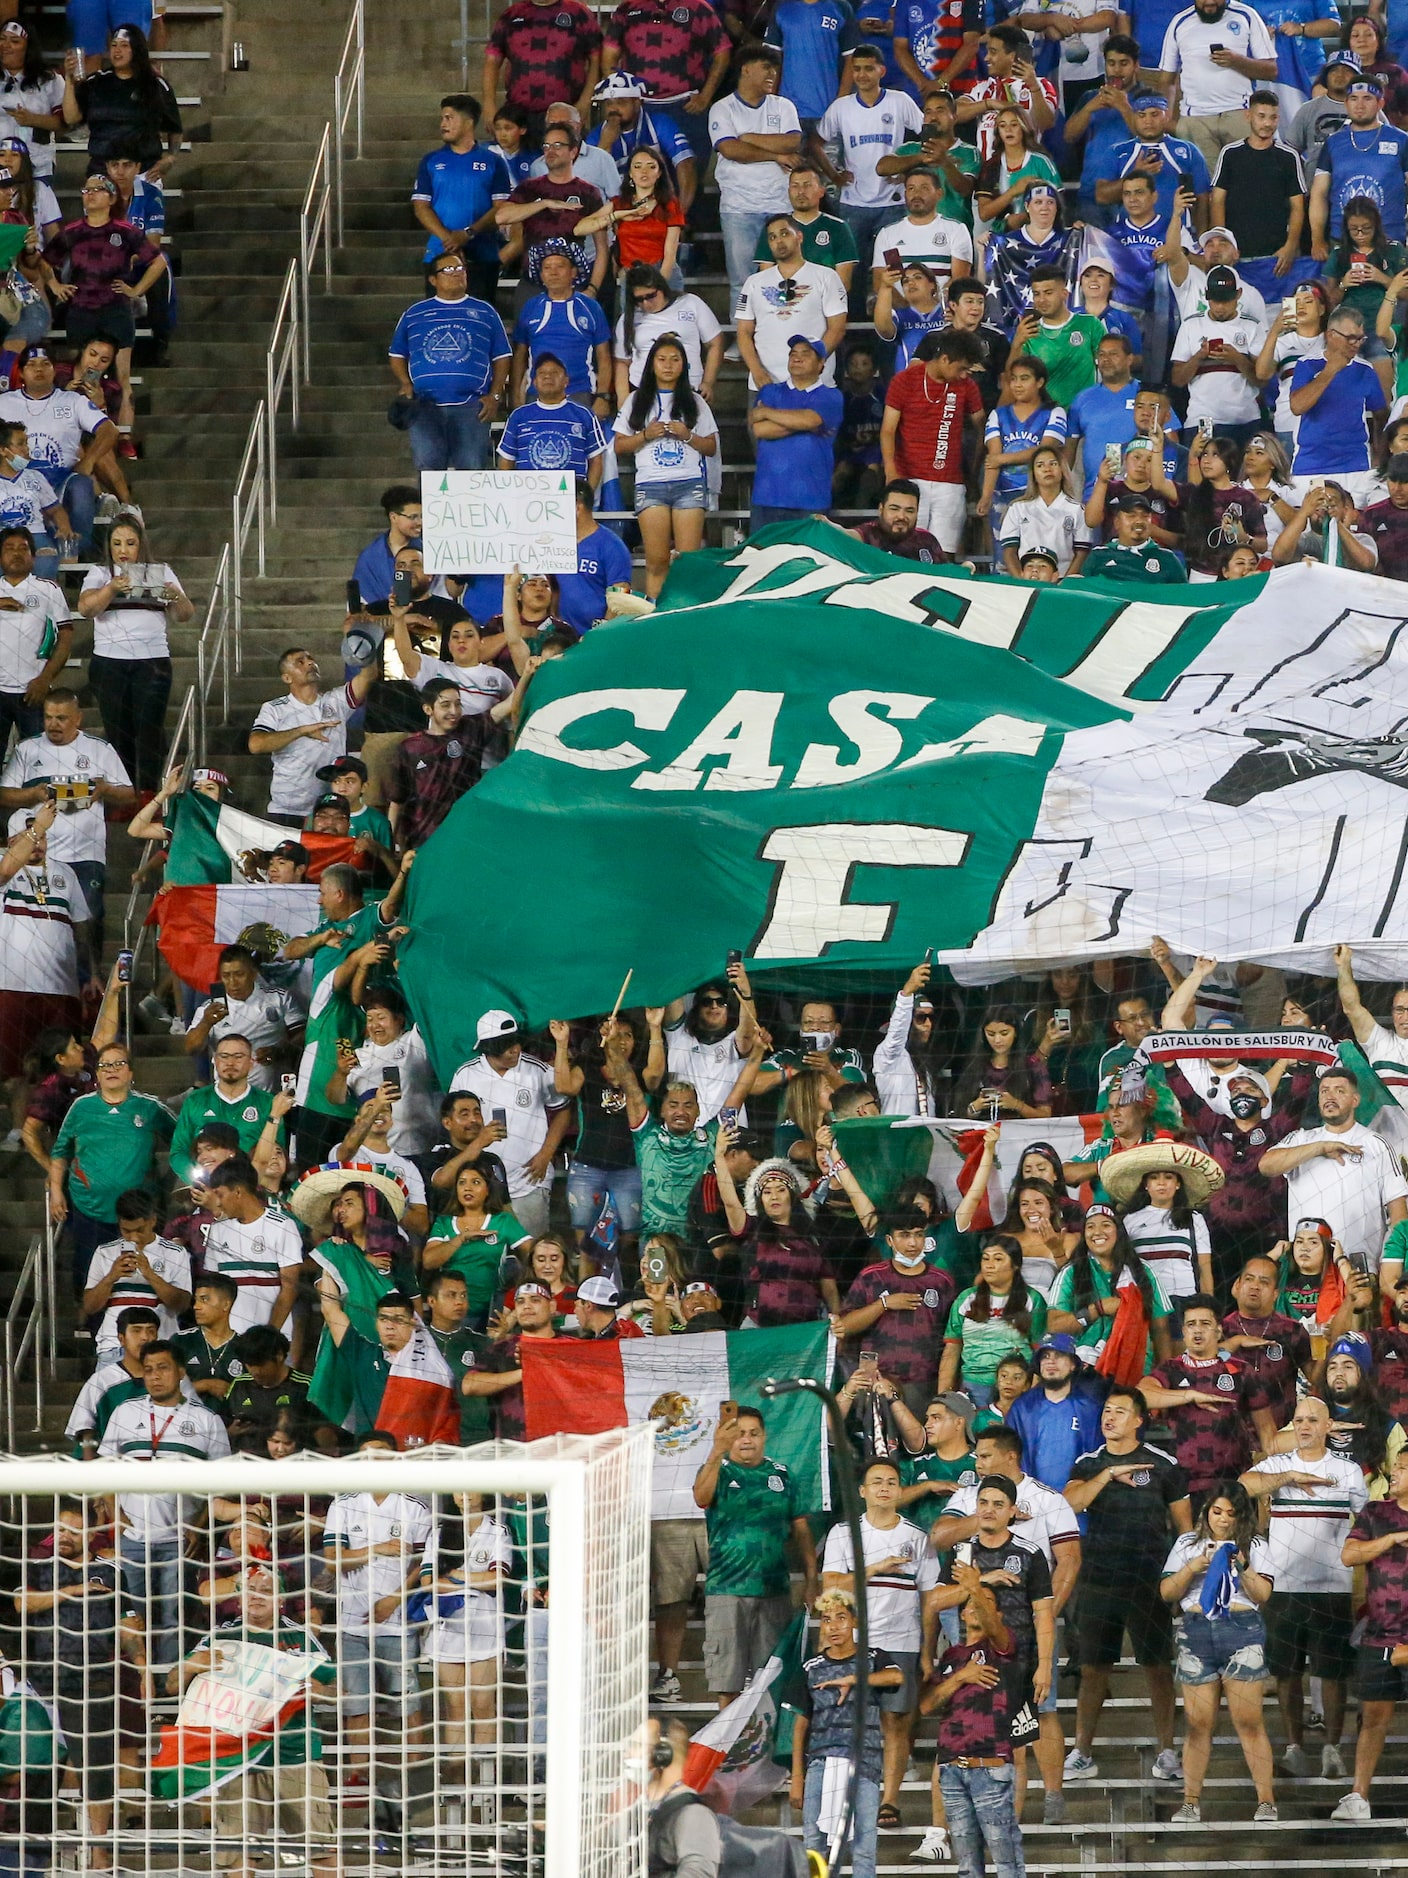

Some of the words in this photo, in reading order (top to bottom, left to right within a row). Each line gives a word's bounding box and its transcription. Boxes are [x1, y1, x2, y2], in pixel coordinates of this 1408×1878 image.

[821, 15, 838, 30] ES
[1378, 141, 1398, 156] ES
[473, 161, 487, 173] ES
[132, 216, 145, 230] ES
[677, 310, 695, 323] ES
[54, 406, 71, 420] ES
[940, 420, 953, 441] POLO
[24, 479, 42, 492] ES
[469, 472, 551, 492] SALUDOS
[426, 499, 511, 532] SALEM,
[525, 499, 565, 524] OR
[430, 537, 539, 569] YAHUALICA
[539, 546, 576, 557] JALISCO
[579, 558, 600, 575] ES
[515, 688, 1048, 796] CASA
[1152, 1034, 1224, 1049] BATALLÓN
[1224, 1036, 1241, 1046] DE
[1244, 1034, 1314, 1047] SALISBURY
[1317, 1039, 1335, 1053] NC
[1171, 1145, 1211, 1175] VIVA
[1010, 1717, 1039, 1738] didas
